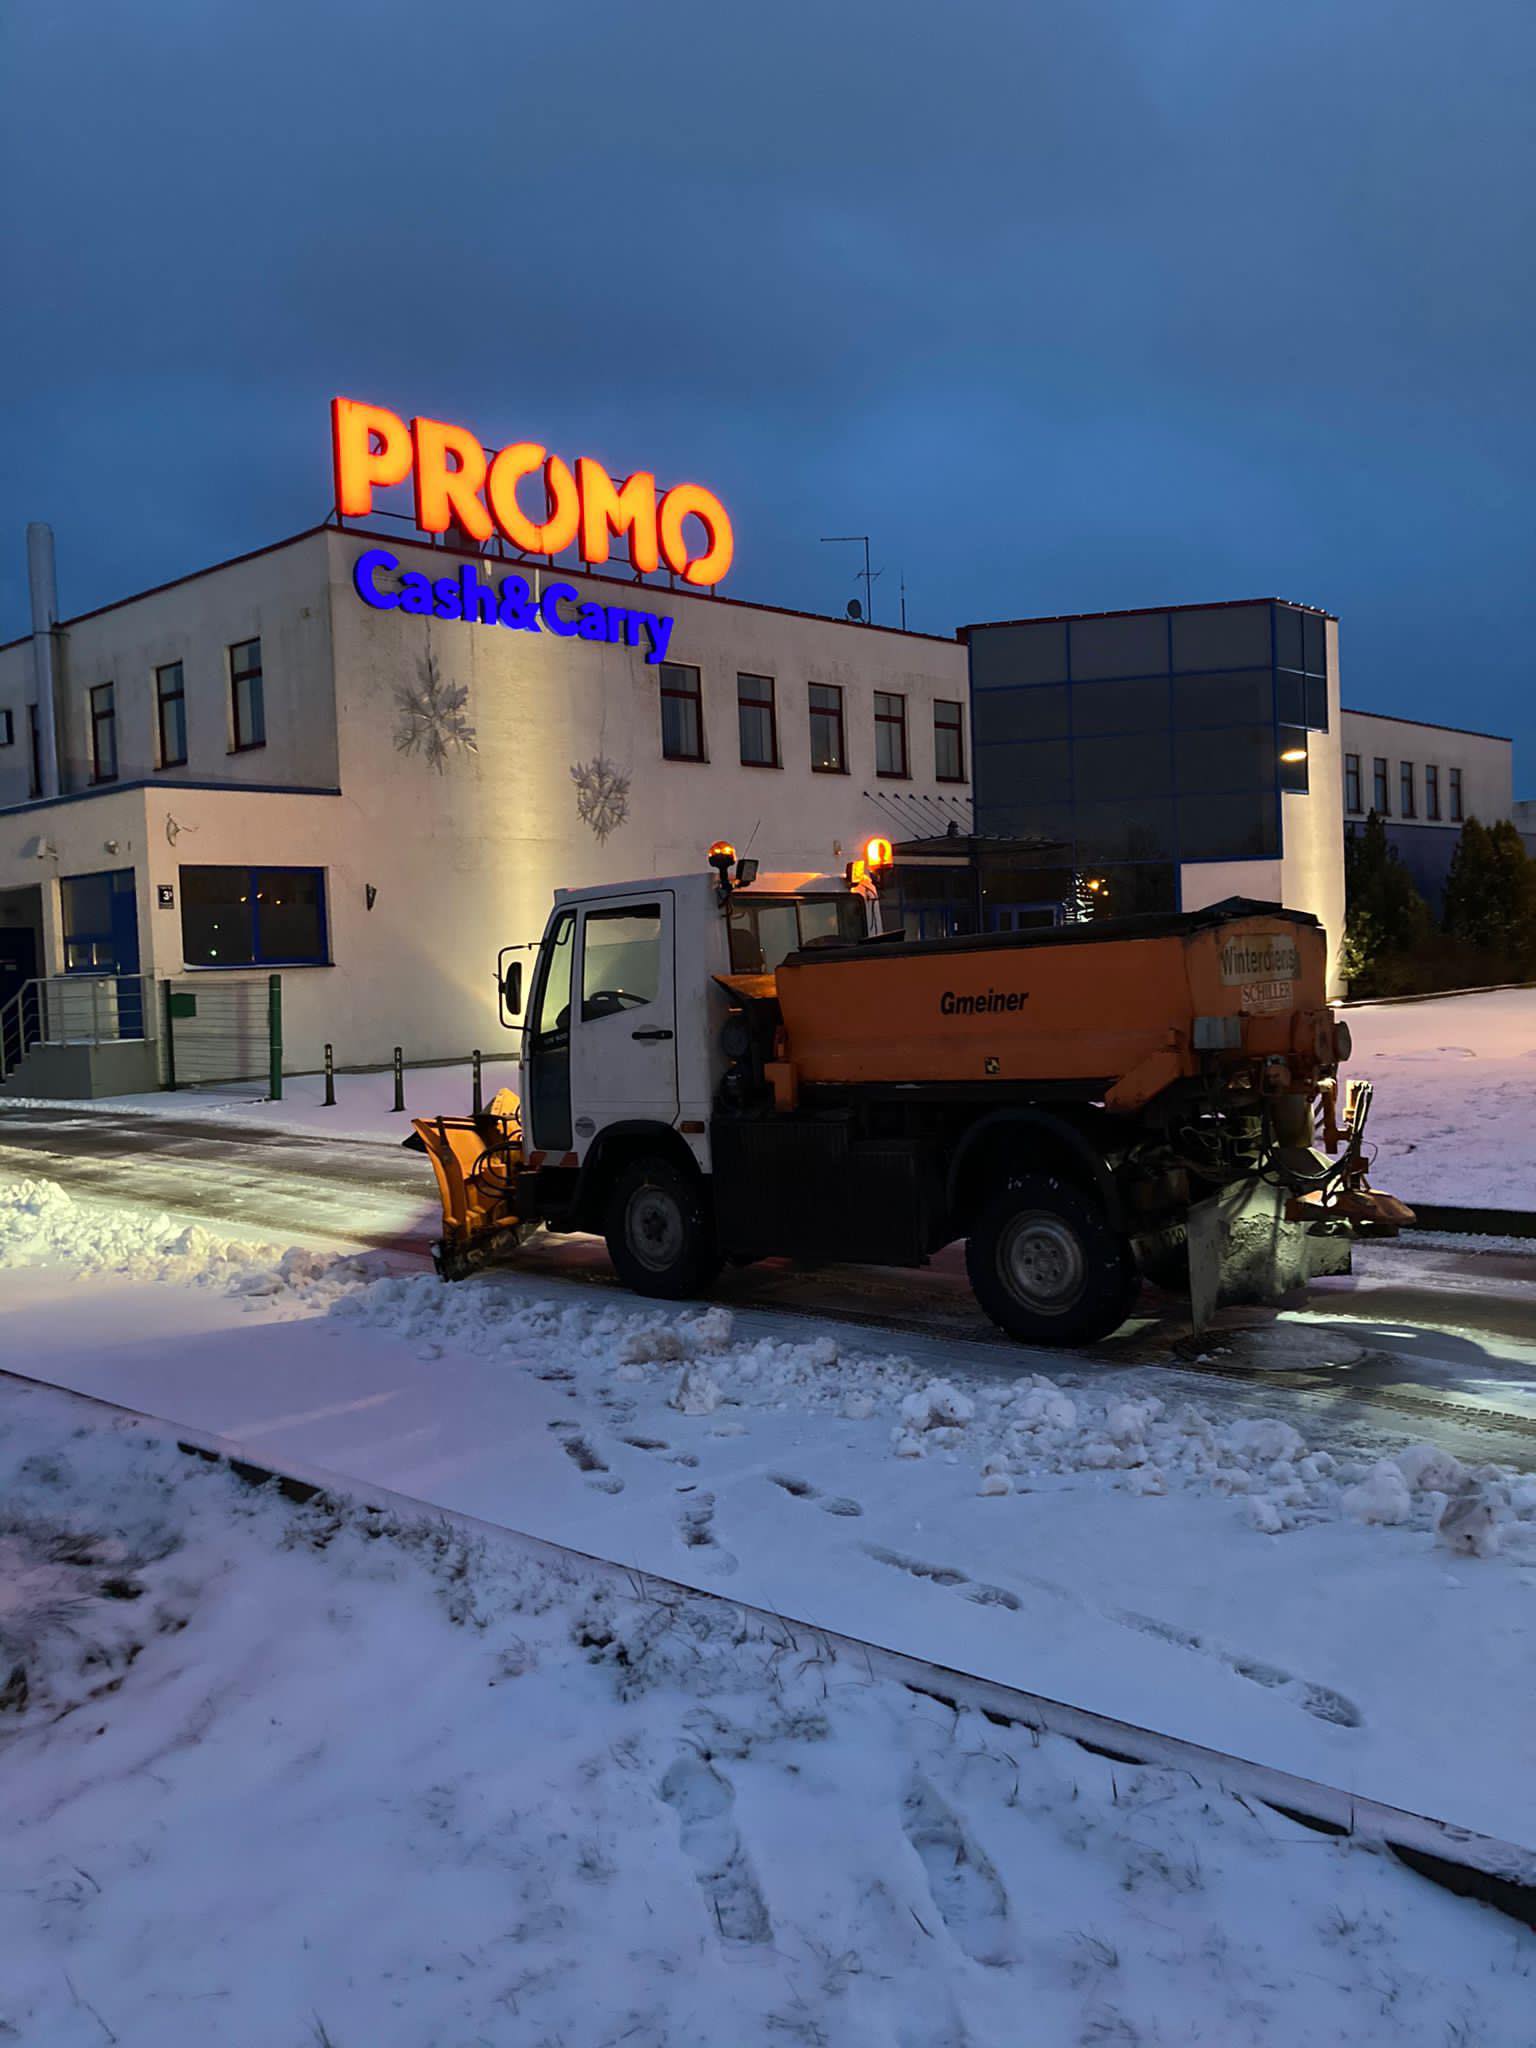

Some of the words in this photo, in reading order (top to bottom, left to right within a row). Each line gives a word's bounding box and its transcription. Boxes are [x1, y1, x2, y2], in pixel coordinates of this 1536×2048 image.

[331, 396, 734, 586] PROMO
[354, 549, 674, 665] Cash&Carry
[940, 987, 1030, 1016] Gmeiner
